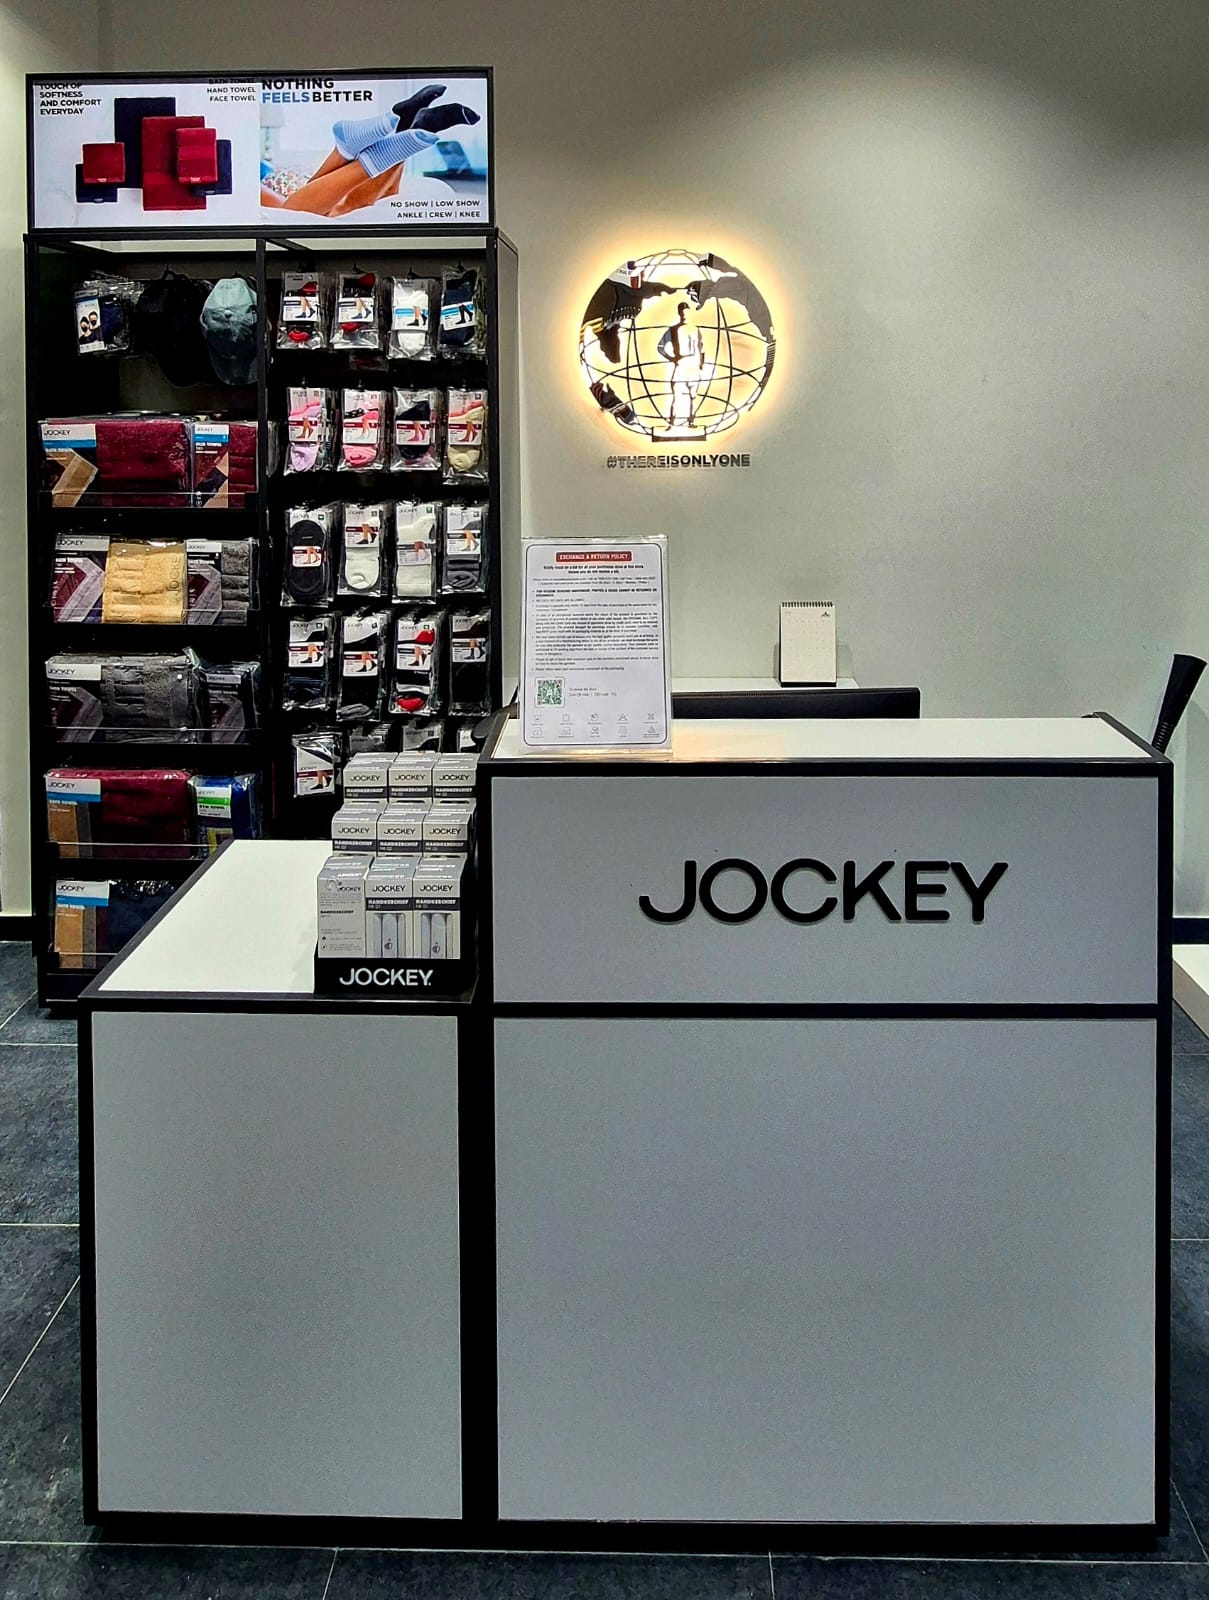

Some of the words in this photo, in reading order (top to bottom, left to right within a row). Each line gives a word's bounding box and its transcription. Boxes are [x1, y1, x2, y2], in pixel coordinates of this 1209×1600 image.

[262, 78, 335, 90] NOTHING
[262, 92, 310, 103] FEELS
[312, 90, 373, 102] BETTER
[60, 99, 102, 107] COMFORT
[459, 210, 481, 218] KNEE
[606, 454, 751, 469] #THEREISONLYONE
[638, 857, 1009, 925] JOCKEY
